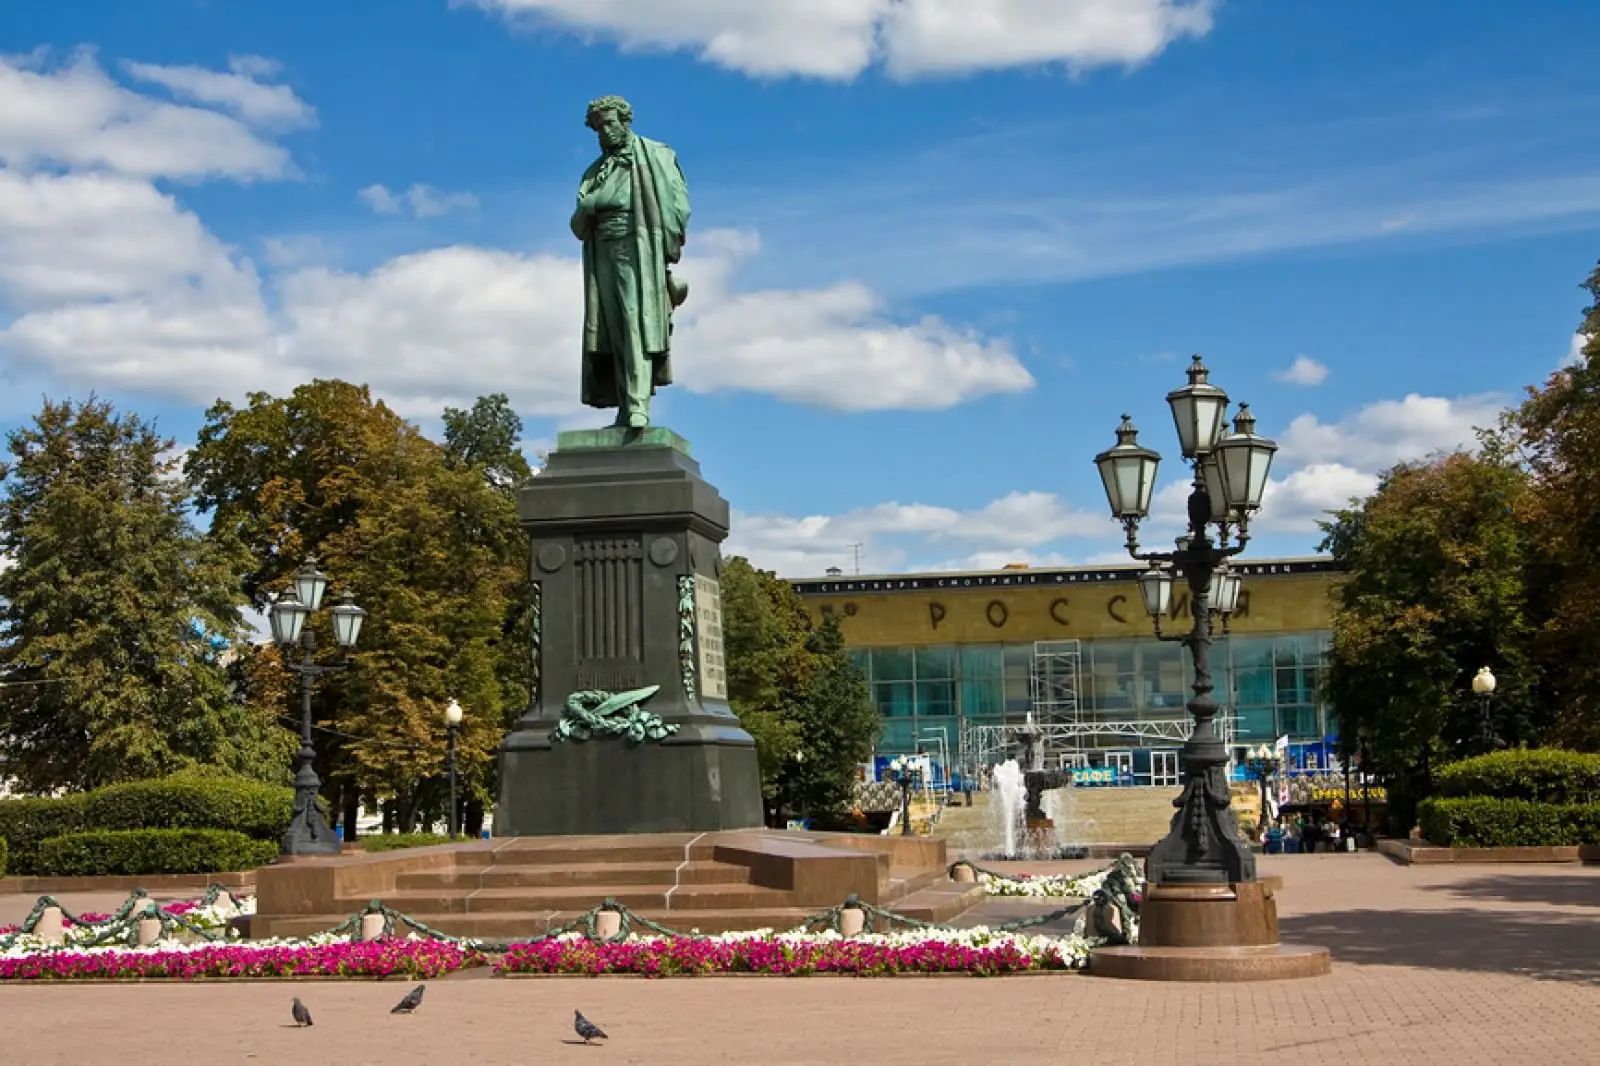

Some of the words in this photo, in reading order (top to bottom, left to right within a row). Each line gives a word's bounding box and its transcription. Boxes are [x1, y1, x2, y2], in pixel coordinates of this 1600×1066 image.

[821, 581, 918, 592] СЕНТЯБРЯ
[938, 575, 1035, 586] СМОТРИТЕ
[1056, 572, 1116, 582] ФИЛЬМ
[930, 590, 1250, 630] РОССИЯ
[1071, 769, 1113, 782] КАФЕ
